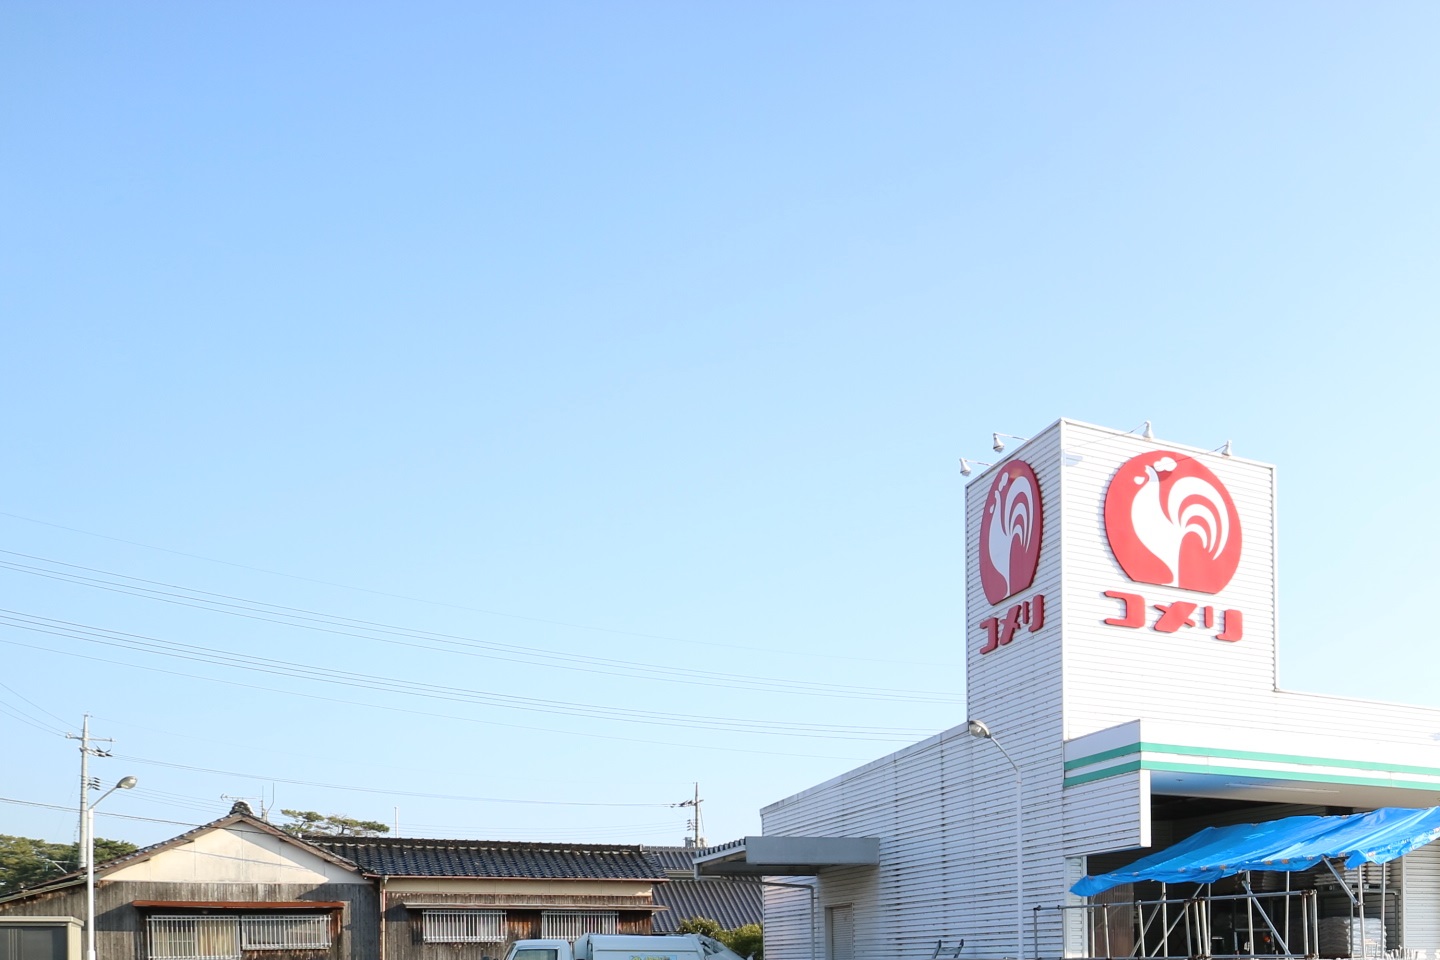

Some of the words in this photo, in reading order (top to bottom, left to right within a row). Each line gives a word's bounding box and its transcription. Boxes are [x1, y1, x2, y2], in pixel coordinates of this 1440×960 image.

[979, 594, 1045, 655] コメリ
[1104, 590, 1244, 643] コメリ
